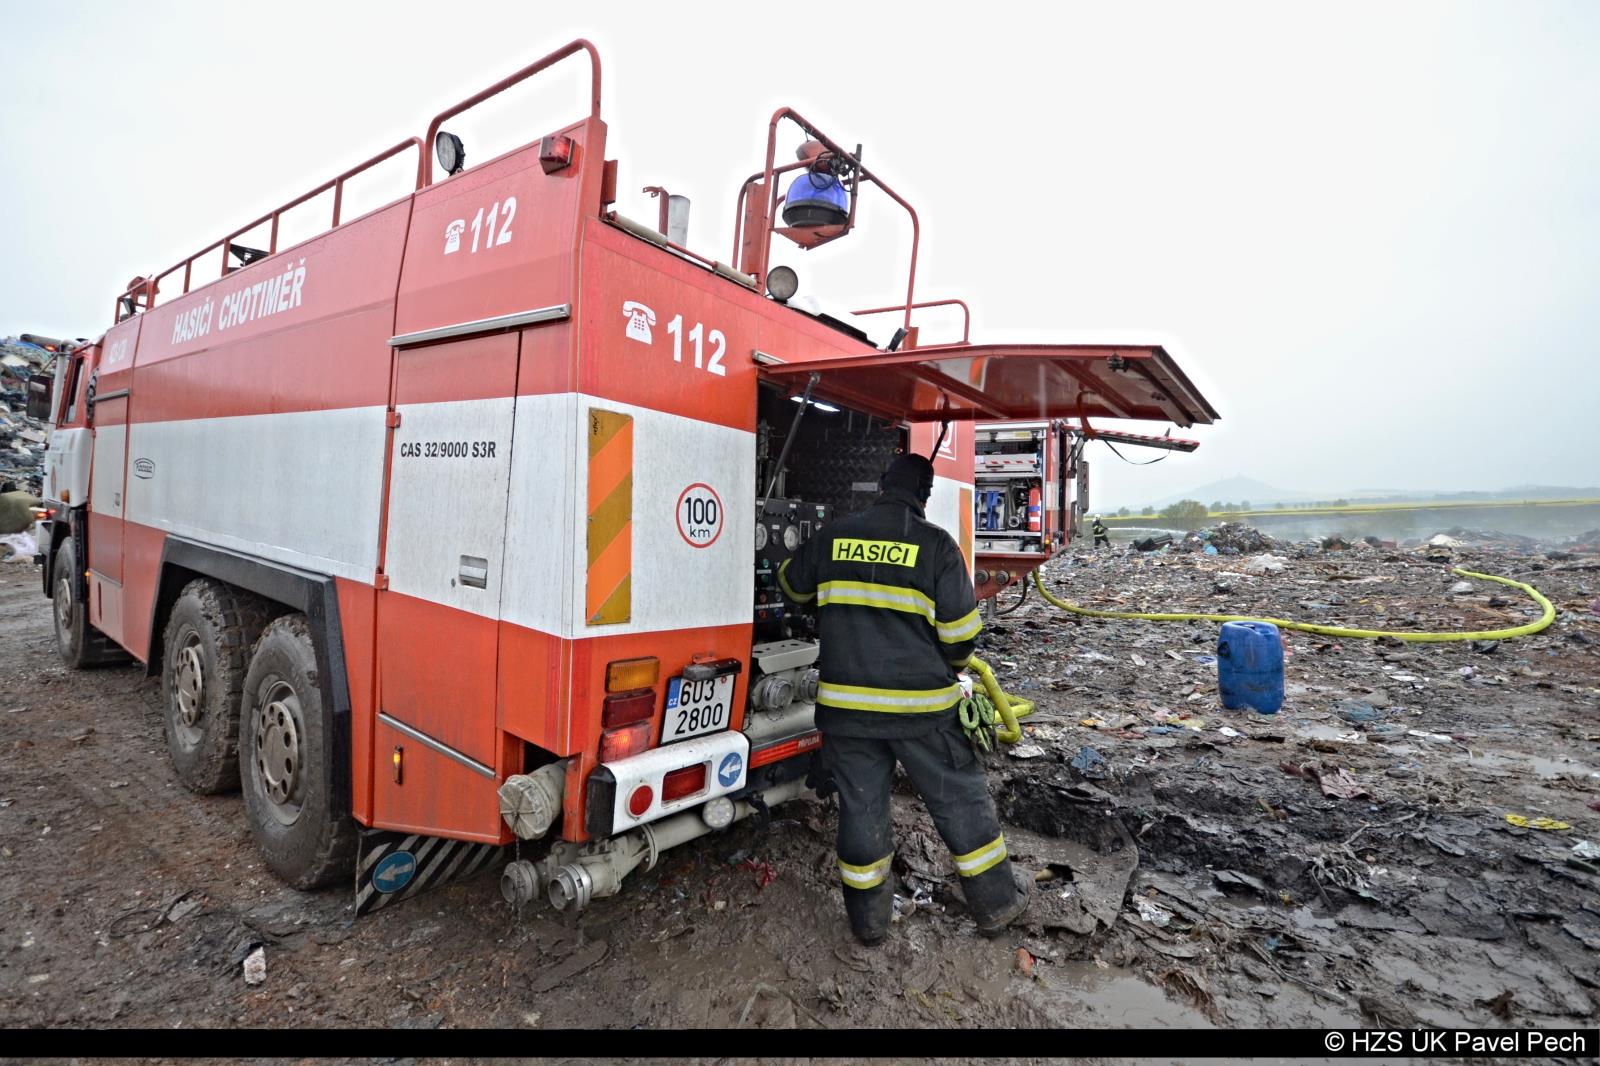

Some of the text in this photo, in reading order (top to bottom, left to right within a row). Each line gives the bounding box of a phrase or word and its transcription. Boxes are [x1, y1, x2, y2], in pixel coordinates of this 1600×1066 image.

[470, 195, 517, 254] 112
[171, 257, 306, 345] HASIČI CHOTIMĚŘ
[667, 313, 726, 377] 112
[400, 441, 496, 458] CAS 32/9000 S3R
[685, 496, 717, 525] 100
[689, 525, 711, 538] km
[837, 542, 910, 564] HASIČI
[668, 697, 678, 706] CZ
[680, 679, 715, 706] 6U3
[674, 702, 723, 735] 2800
